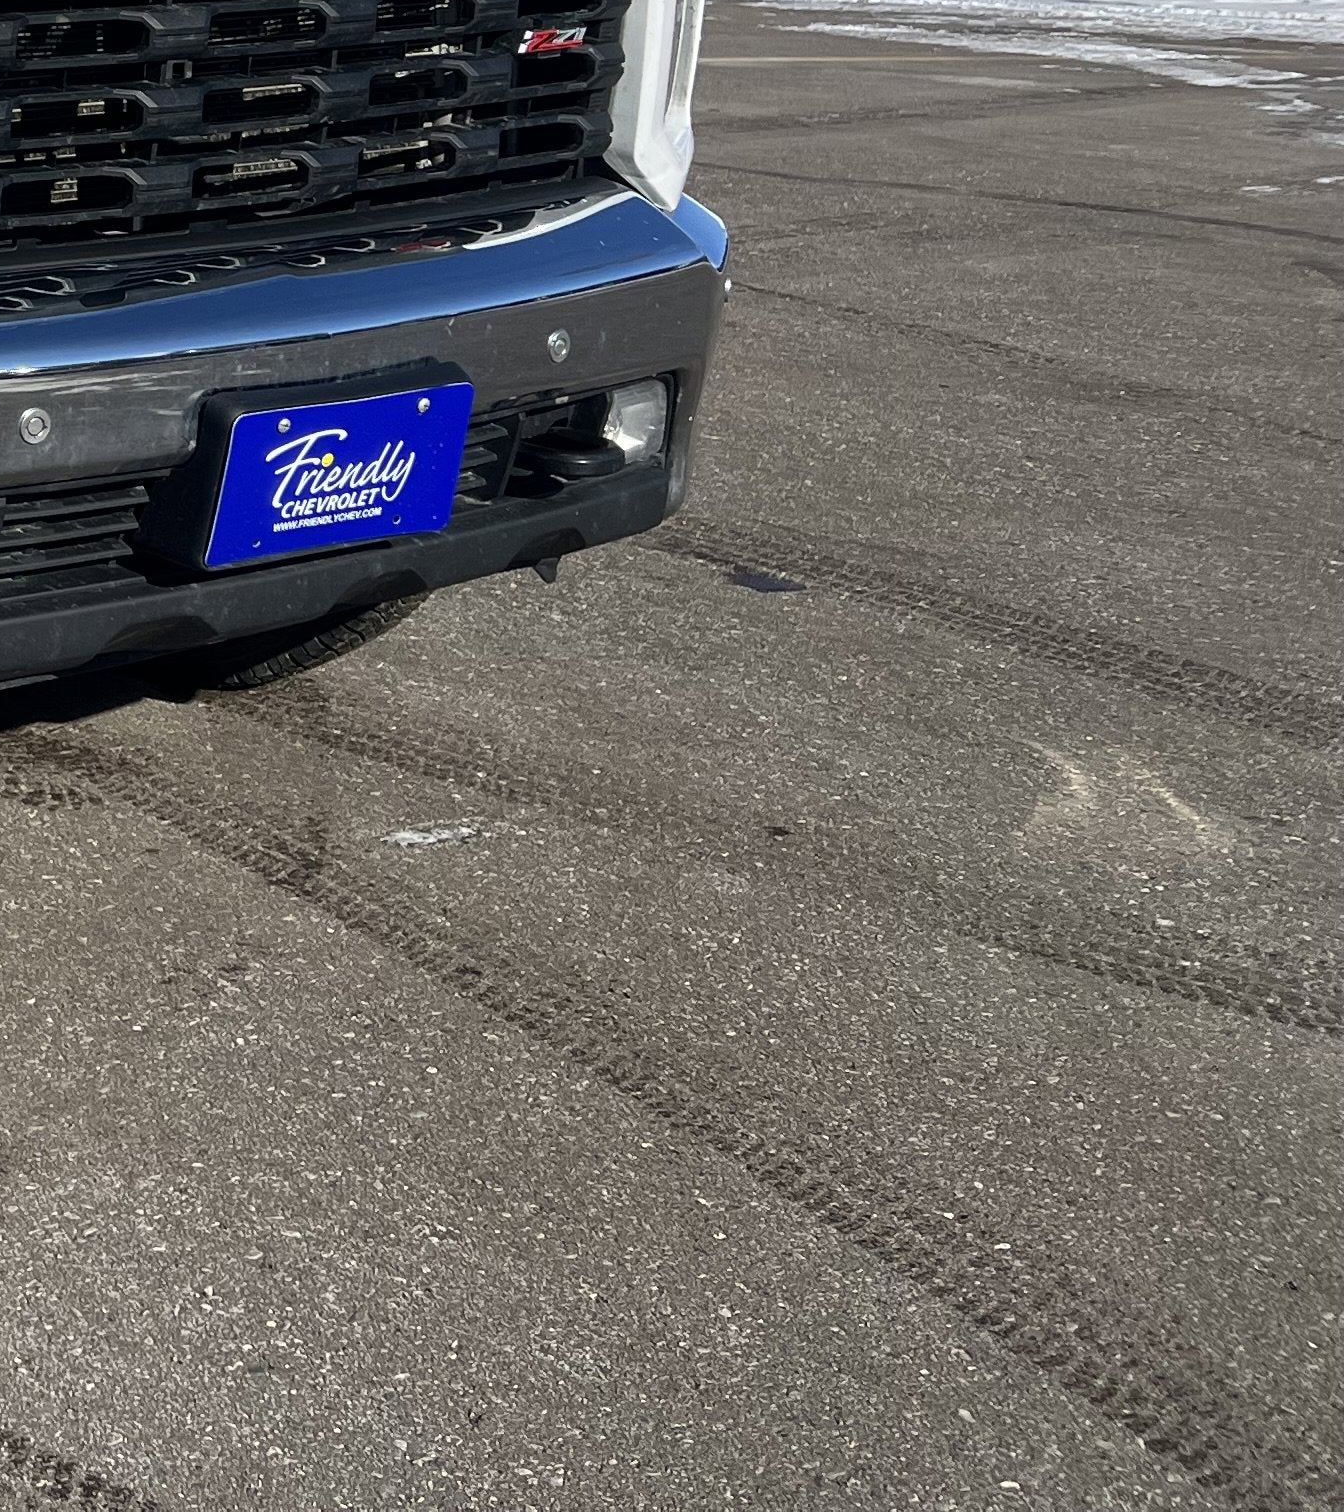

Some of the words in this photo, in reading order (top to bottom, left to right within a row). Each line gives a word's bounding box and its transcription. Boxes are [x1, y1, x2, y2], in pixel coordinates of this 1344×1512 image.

[517, 26, 588, 55] Z71
[265, 428, 416, 508] Friendly
[280, 487, 381, 519] CHEVROLET
[272, 506, 383, 533] WWW.FRIENDLYCHEV.COM
